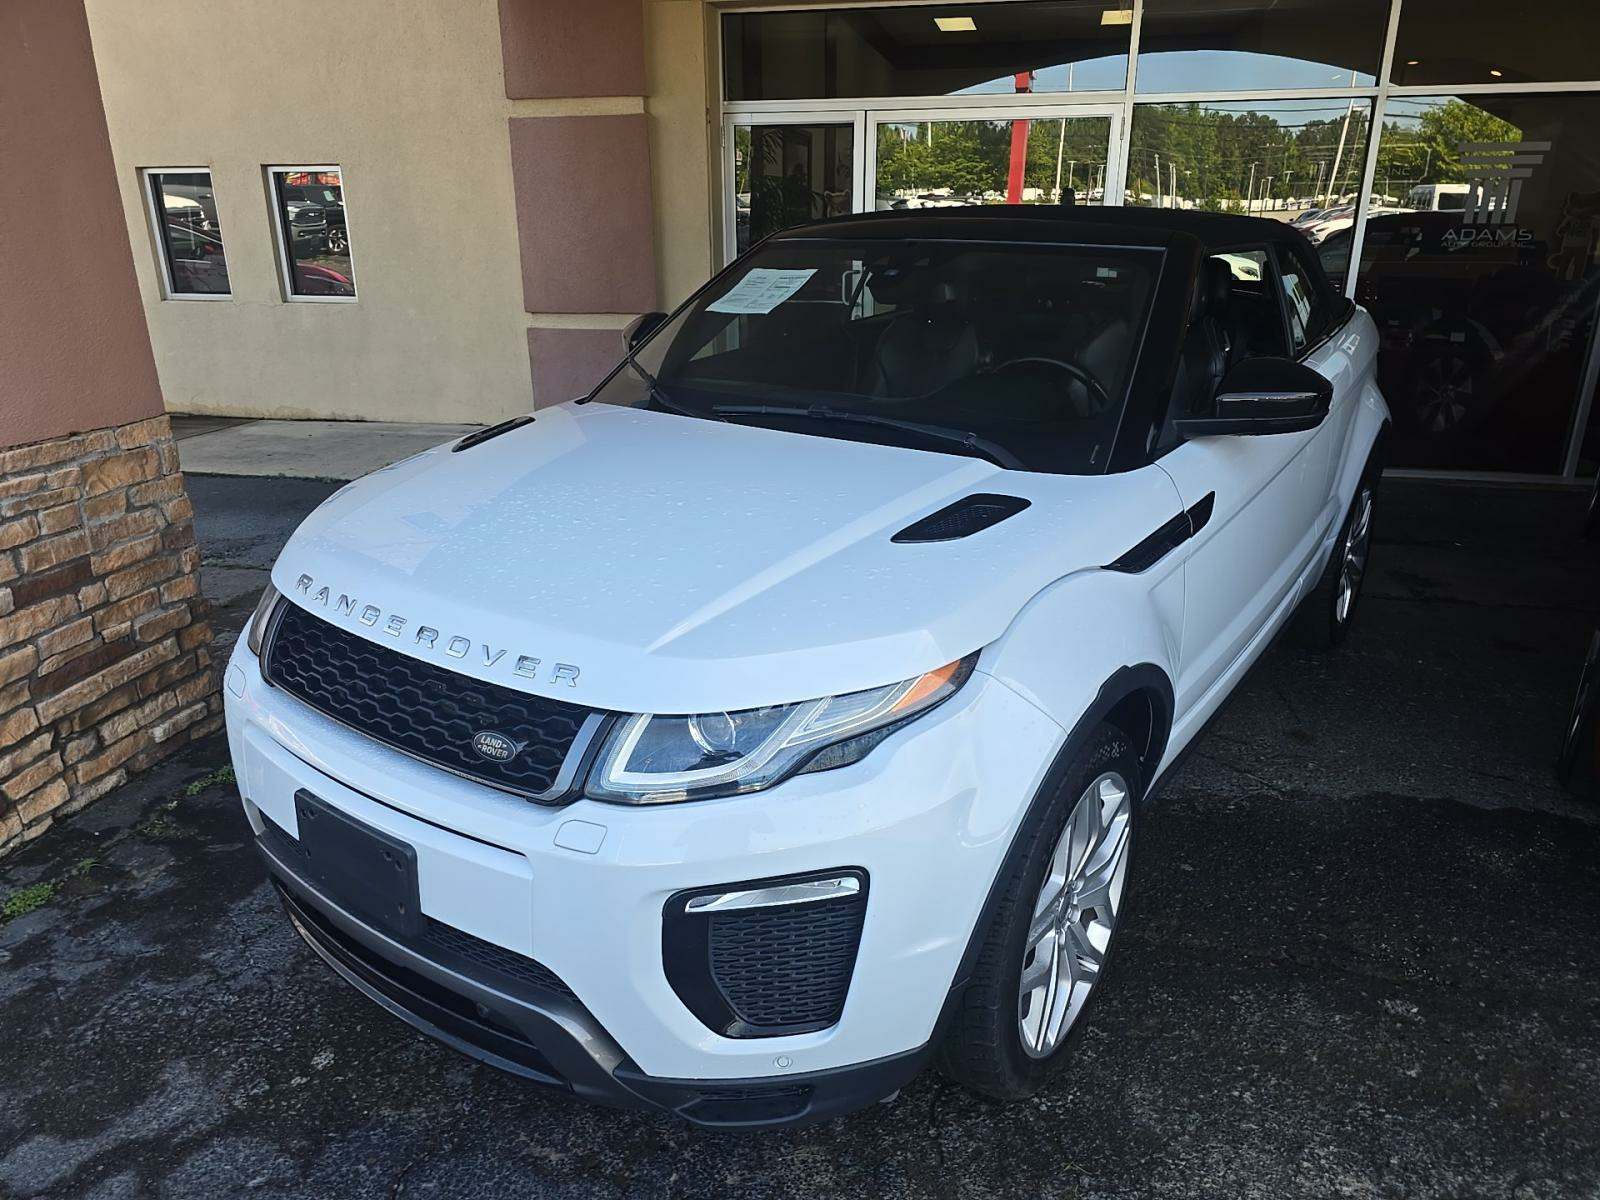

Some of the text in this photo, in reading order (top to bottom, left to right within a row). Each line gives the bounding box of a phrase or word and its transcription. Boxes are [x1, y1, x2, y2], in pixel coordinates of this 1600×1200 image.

[1440, 228, 1532, 241] ADAMS
[296, 573, 581, 688] RANGE ROVER
[480, 735, 502, 748] LAND
[481, 745, 508, 758] ROVER
